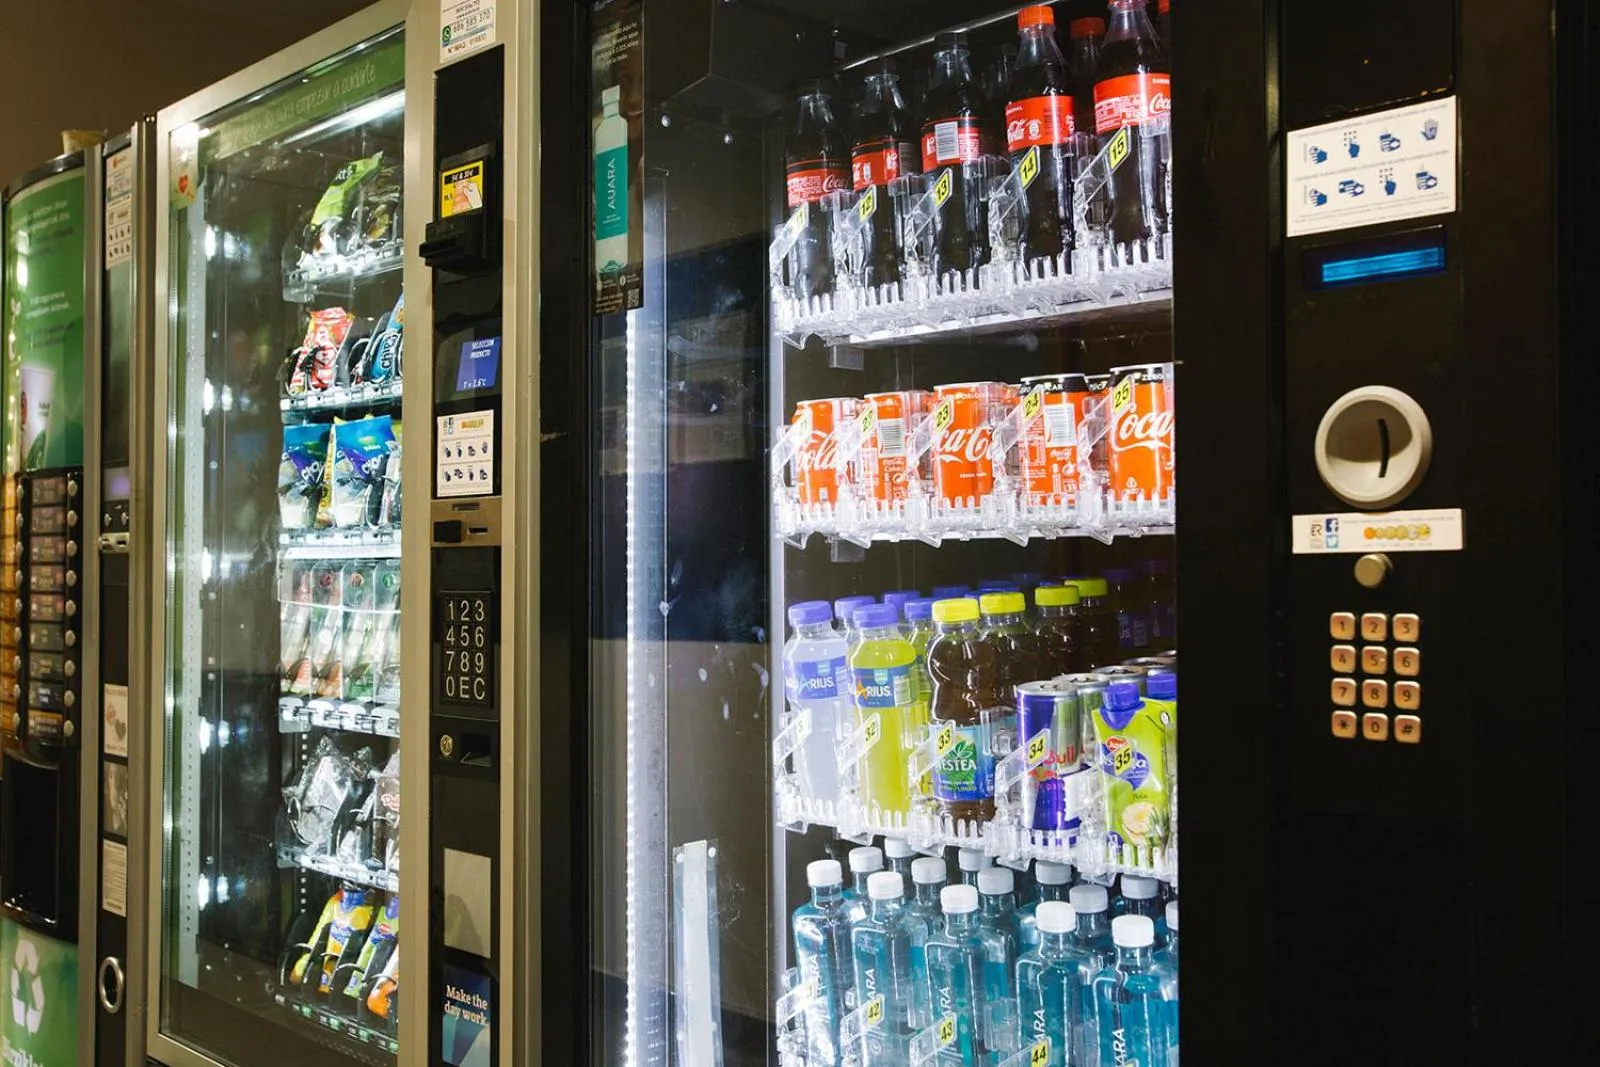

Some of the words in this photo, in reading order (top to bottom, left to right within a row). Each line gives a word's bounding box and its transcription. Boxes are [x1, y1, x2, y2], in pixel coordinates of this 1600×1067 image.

[1111, 137, 1124, 160] 15
[1022, 162, 1034, 179] 14
[937, 180, 947, 200] 13
[861, 196, 872, 213] 12
[1025, 393, 1038, 416] 24
[1115, 384, 1129, 408] 25
[936, 404, 948, 428] 23
[448, 600, 454, 620] 1
[461, 600, 470, 620] 2
[475, 600, 484, 621] 3
[446, 625, 455, 646] 4
[461, 626, 470, 646] 5
[475, 626, 484, 647] 6
[1340, 621, 1345, 632] 1
[1370, 621, 1378, 633] 2
[1402, 622, 1410, 634] 3
[446, 651, 455, 671] 7
[461, 651, 469, 672] 8
[475, 652, 484, 673] 9
[1338, 654, 1346, 664] 4
[1370, 654, 1378, 666] 5
[1402, 656, 1410, 668] 6
[446, 676, 455, 697] 0
[460, 676, 470, 698] E
[474, 677, 485, 700] C
[1340, 686, 1347, 697] 7
[1371, 687, 1379, 700] 8
[1402, 689, 1411, 701] 9
[864, 721, 875, 741] 32
[1371, 721, 1379, 733] 0
[939, 729, 950, 749] 33
[1029, 738, 1044, 760] 34
[1115, 747, 1131, 770] 35
[865, 968, 876, 999] ARA
[446, 984, 472, 1005] Make
[472, 994, 488, 1010] the
[444, 1000, 461, 1020] day
[868, 1002, 880, 1018] 42
[941, 1022, 952, 1041] 43
[1033, 1008, 1046, 1041] ARA
[1033, 1046, 1046, 1064] 44
